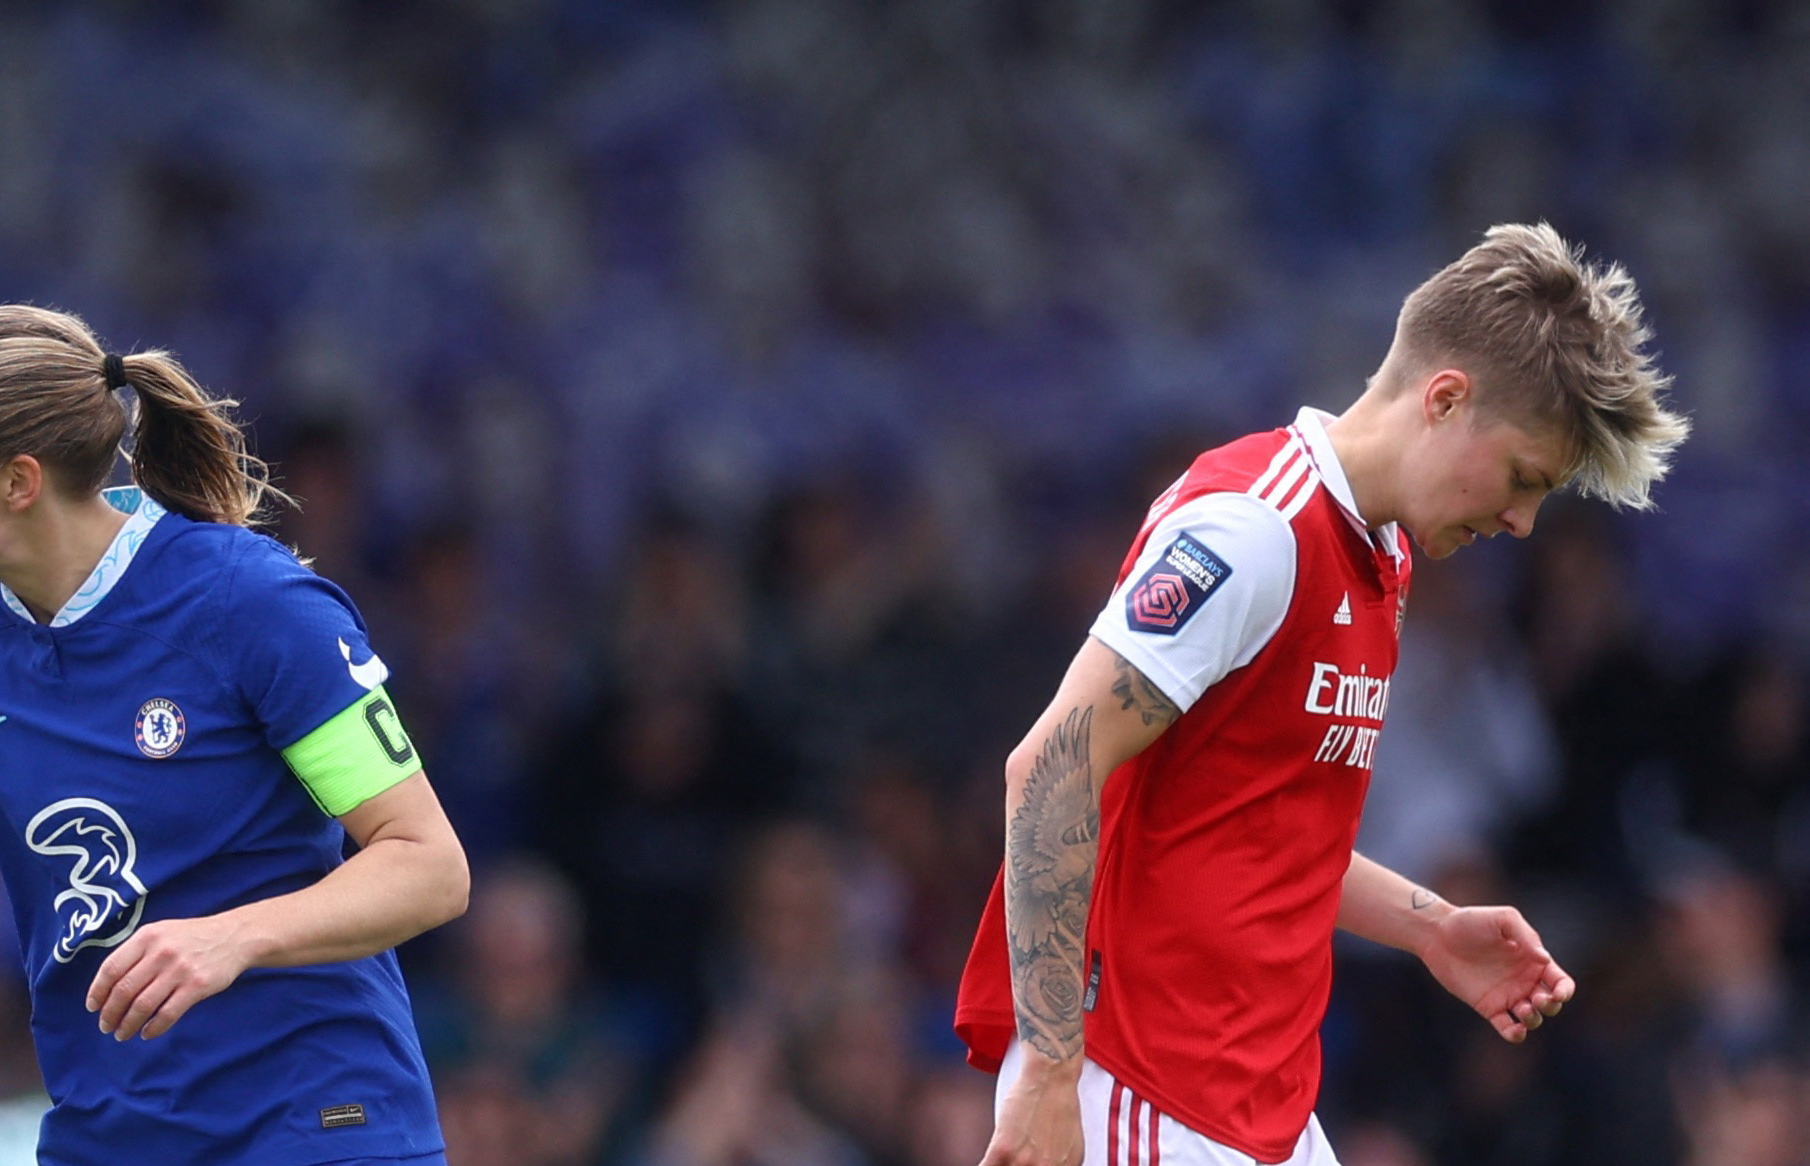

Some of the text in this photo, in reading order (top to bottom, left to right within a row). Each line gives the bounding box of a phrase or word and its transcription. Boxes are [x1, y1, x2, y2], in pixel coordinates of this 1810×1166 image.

[1171, 546, 1216, 586] WOMEN'S
[1185, 543, 1223, 577] BARCLAYS
[1305, 661, 1390, 721] Emirat
[364, 697, 414, 766] C
[1314, 724, 1380, 771] FLY BET
